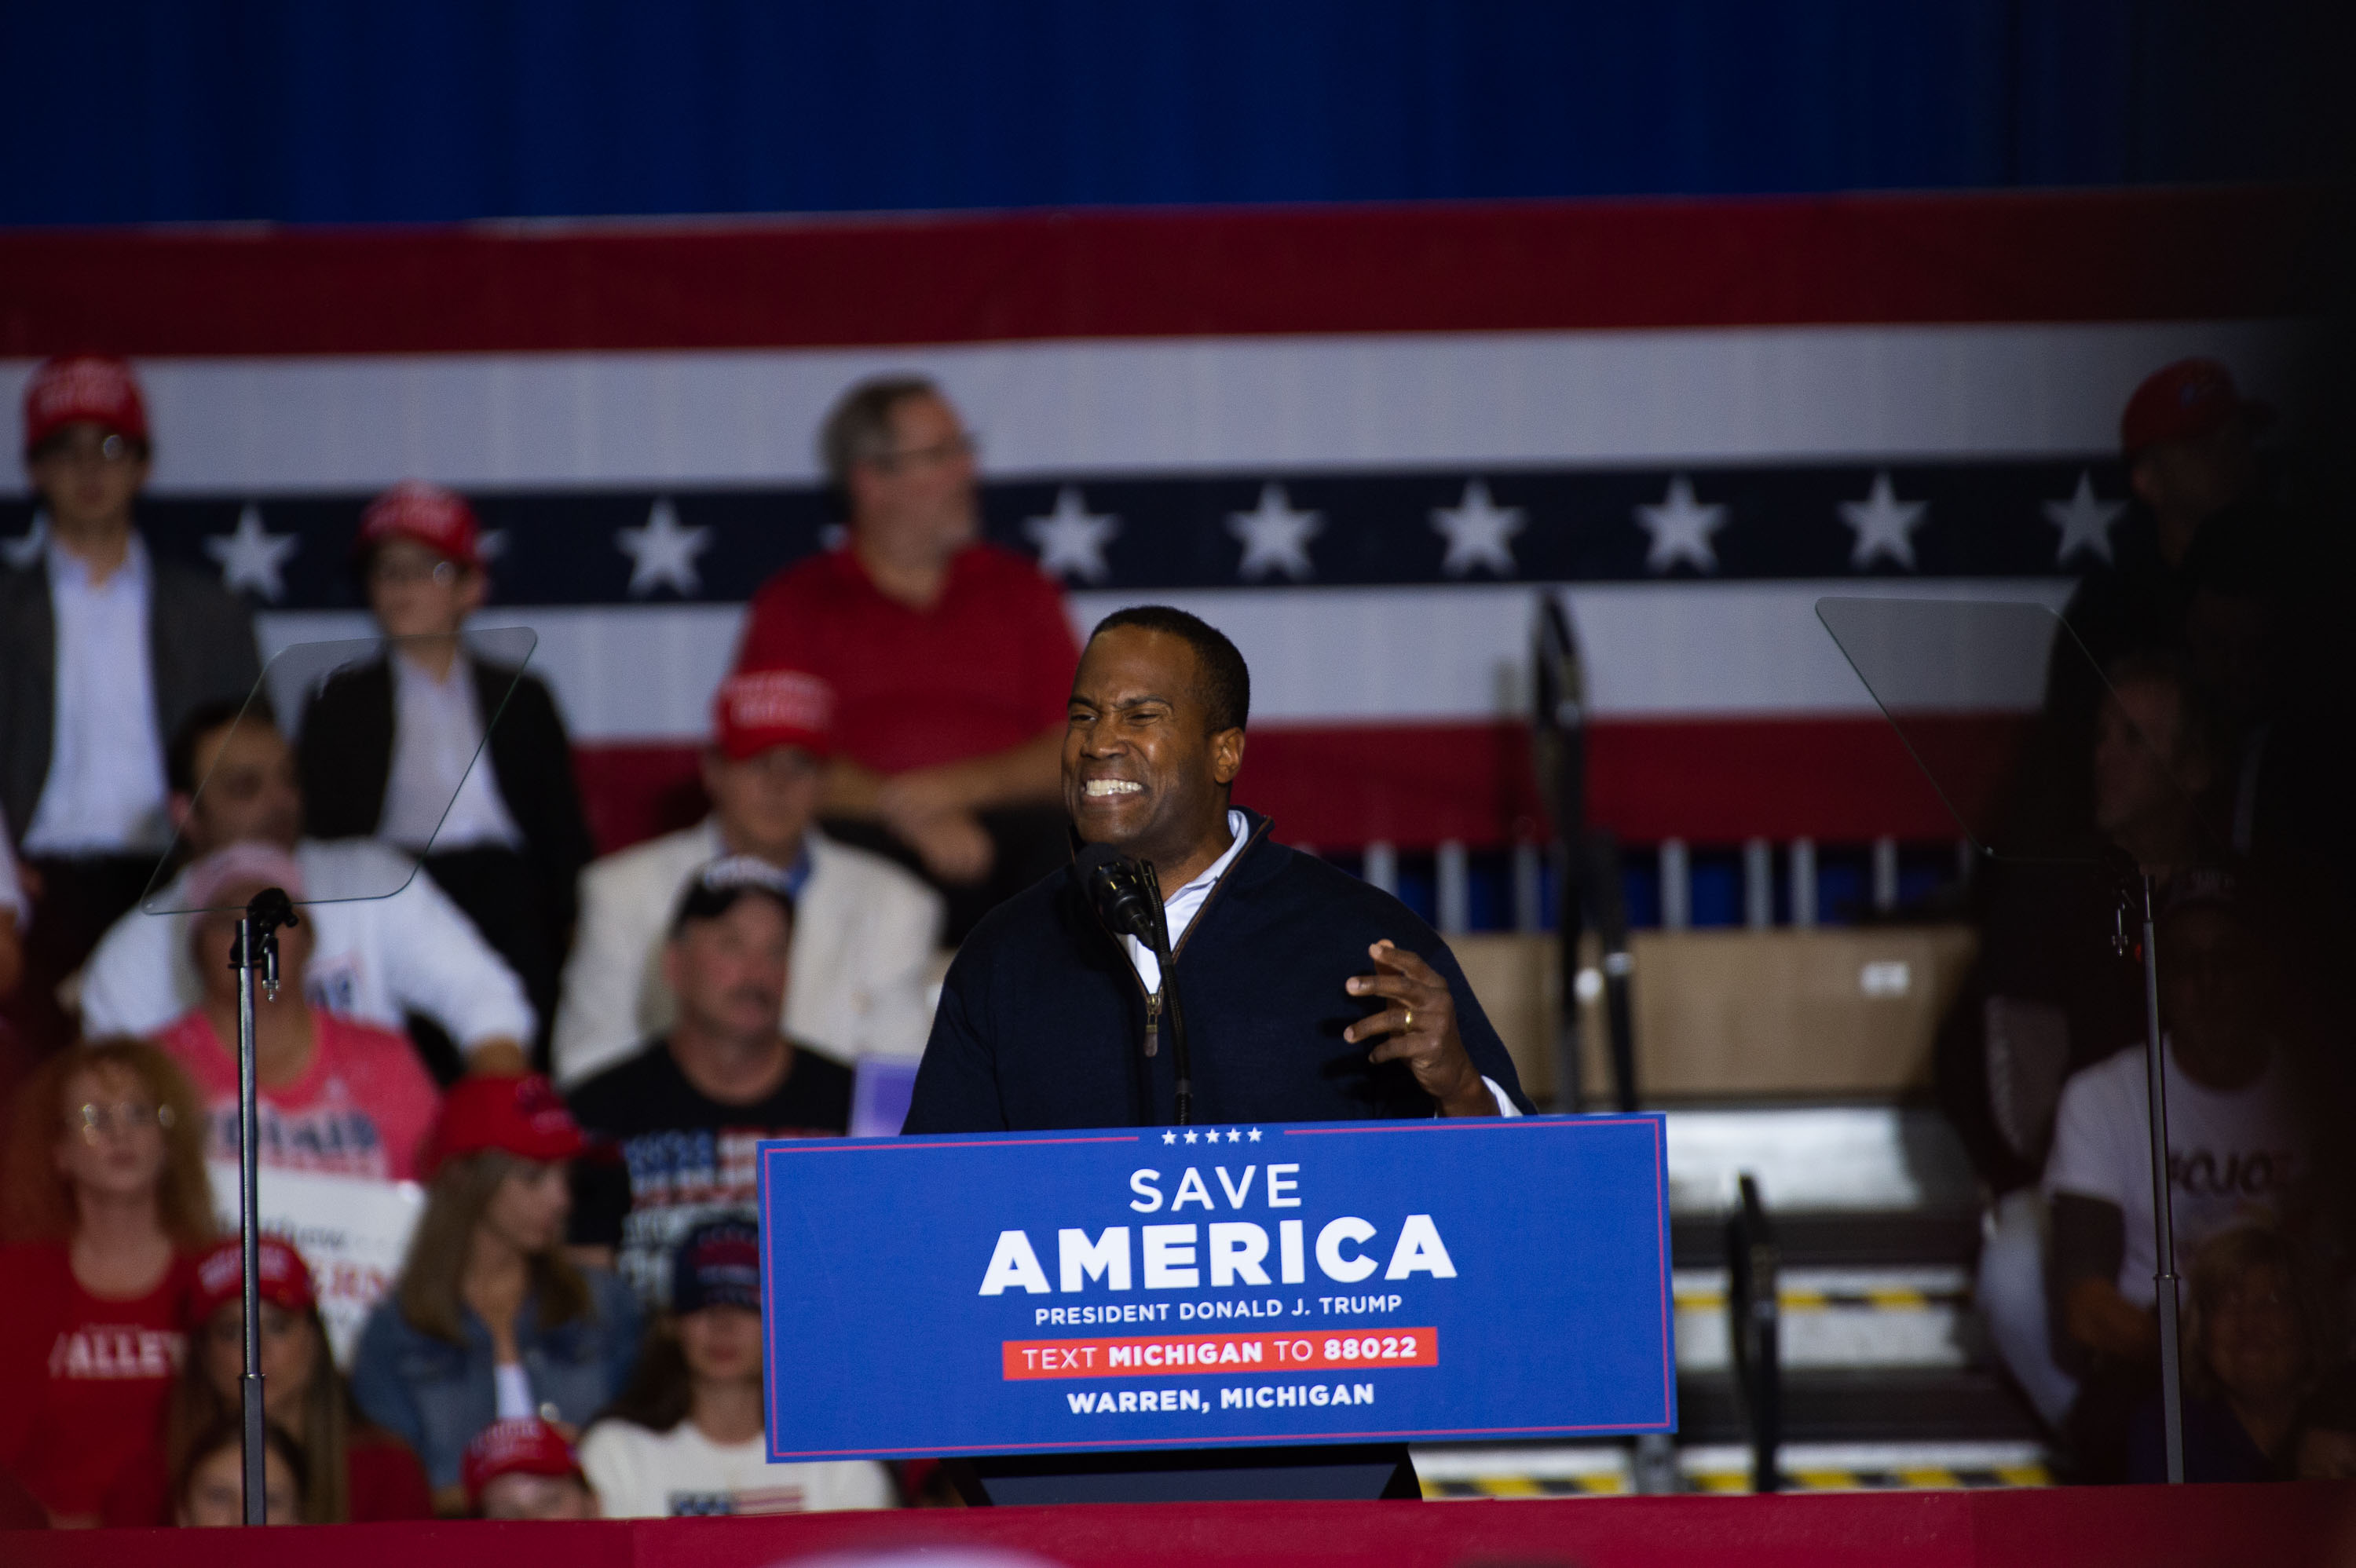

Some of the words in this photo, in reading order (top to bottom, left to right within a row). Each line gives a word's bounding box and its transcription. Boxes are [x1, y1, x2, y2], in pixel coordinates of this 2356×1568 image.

[1129, 1162, 1302, 1214] SAVE
[977, 1214, 1458, 1296] AMERICA
[1035, 1303, 1170, 1325] PRESIDENT
[1179, 1299, 1282, 1321] DONALD
[1291, 1298, 1311, 1316] J.
[1319, 1294, 1402, 1314] TRUMP
[1022, 1347, 1098, 1370] TEXT
[1108, 1341, 1263, 1368] MICHIGAN
[1273, 1340, 1313, 1362] TO
[1323, 1336, 1418, 1361] 88022
[1066, 1389, 1210, 1414] WARREN,
[1220, 1383, 1374, 1409] MICHIGAN
